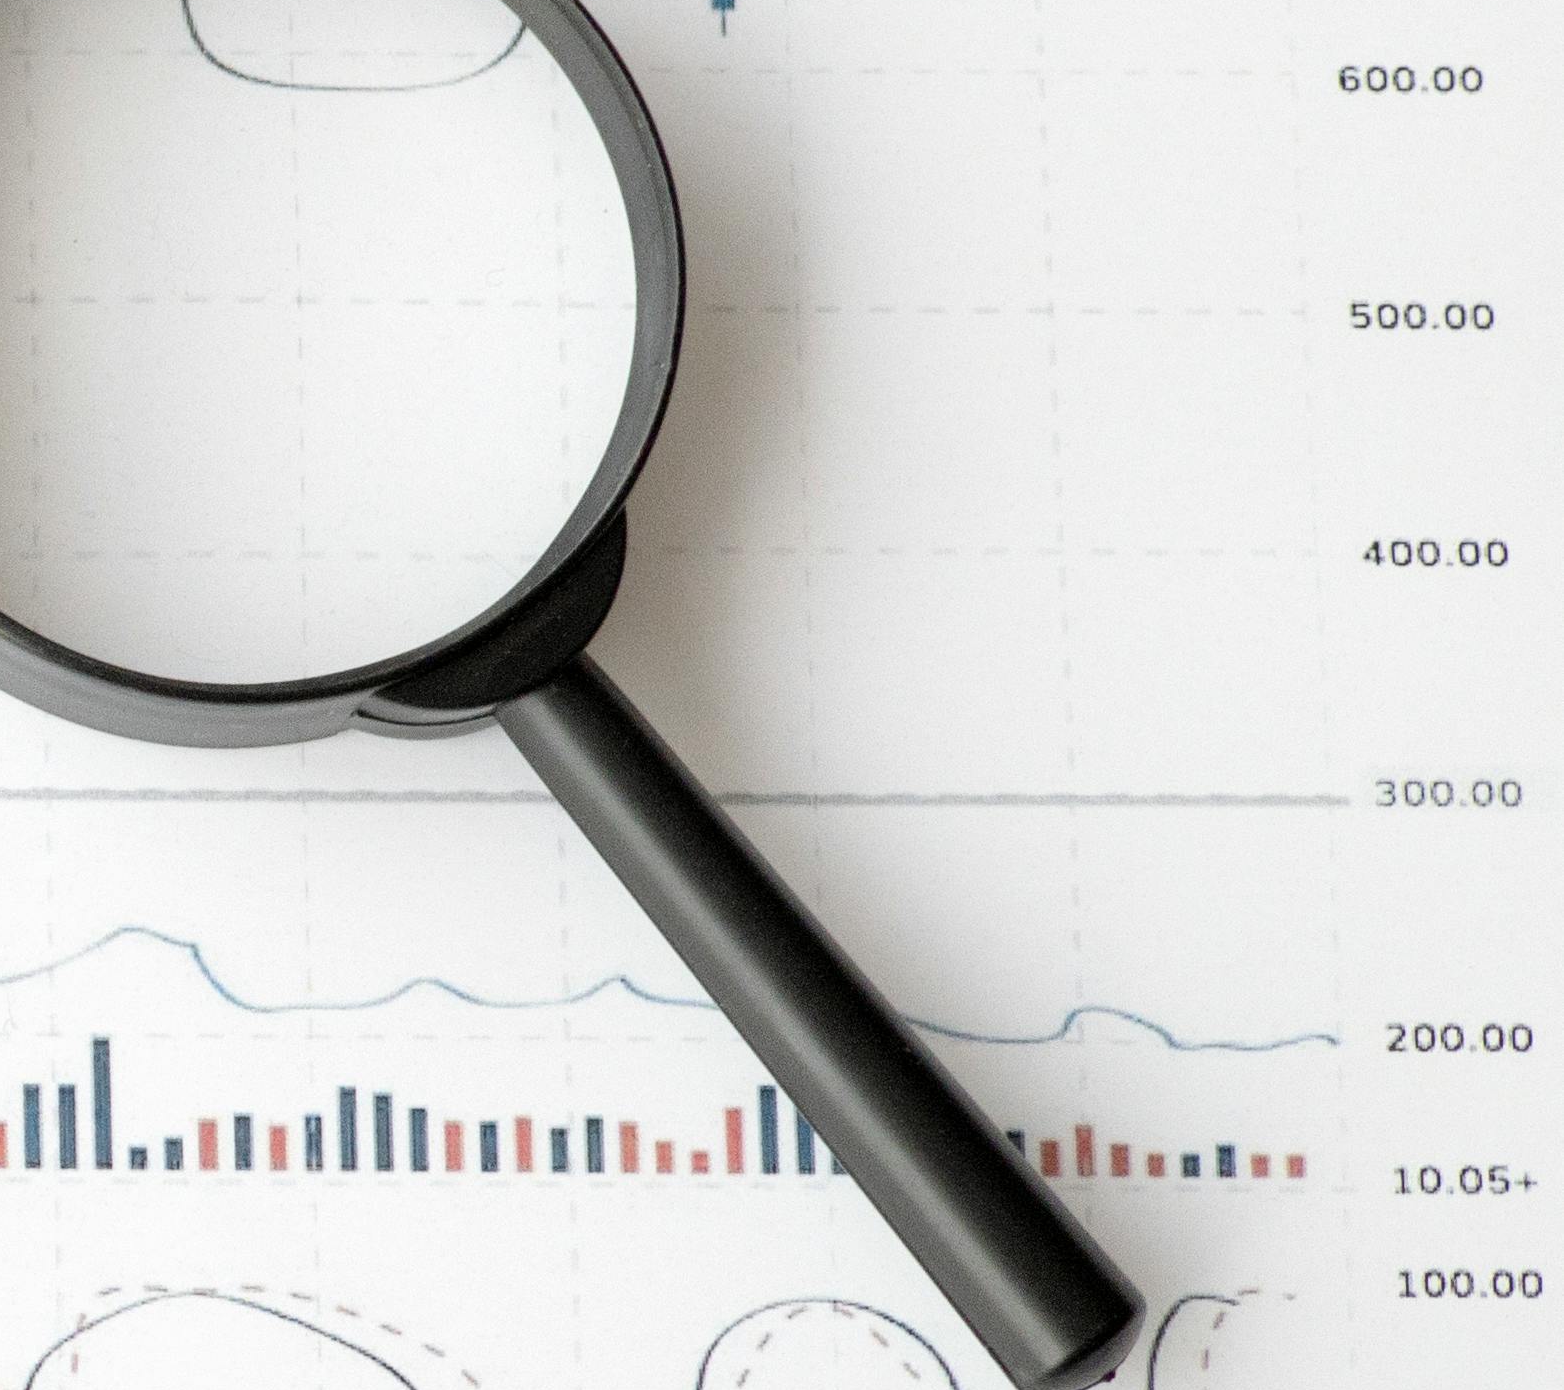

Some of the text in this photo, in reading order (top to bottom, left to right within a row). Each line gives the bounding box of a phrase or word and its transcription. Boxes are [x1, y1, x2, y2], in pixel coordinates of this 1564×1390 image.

[1338, 66, 1484, 93] 600.00
[1350, 302, 1495, 331] 500.00
[1363, 540, 1509, 567] 400.00
[1376, 780, 1523, 808] 300.00
[1388, 1023, 1534, 1053] 200.00
[1396, 1164, 1537, 1195] 10.05+
[1400, 1270, 1544, 1299] 100.00
